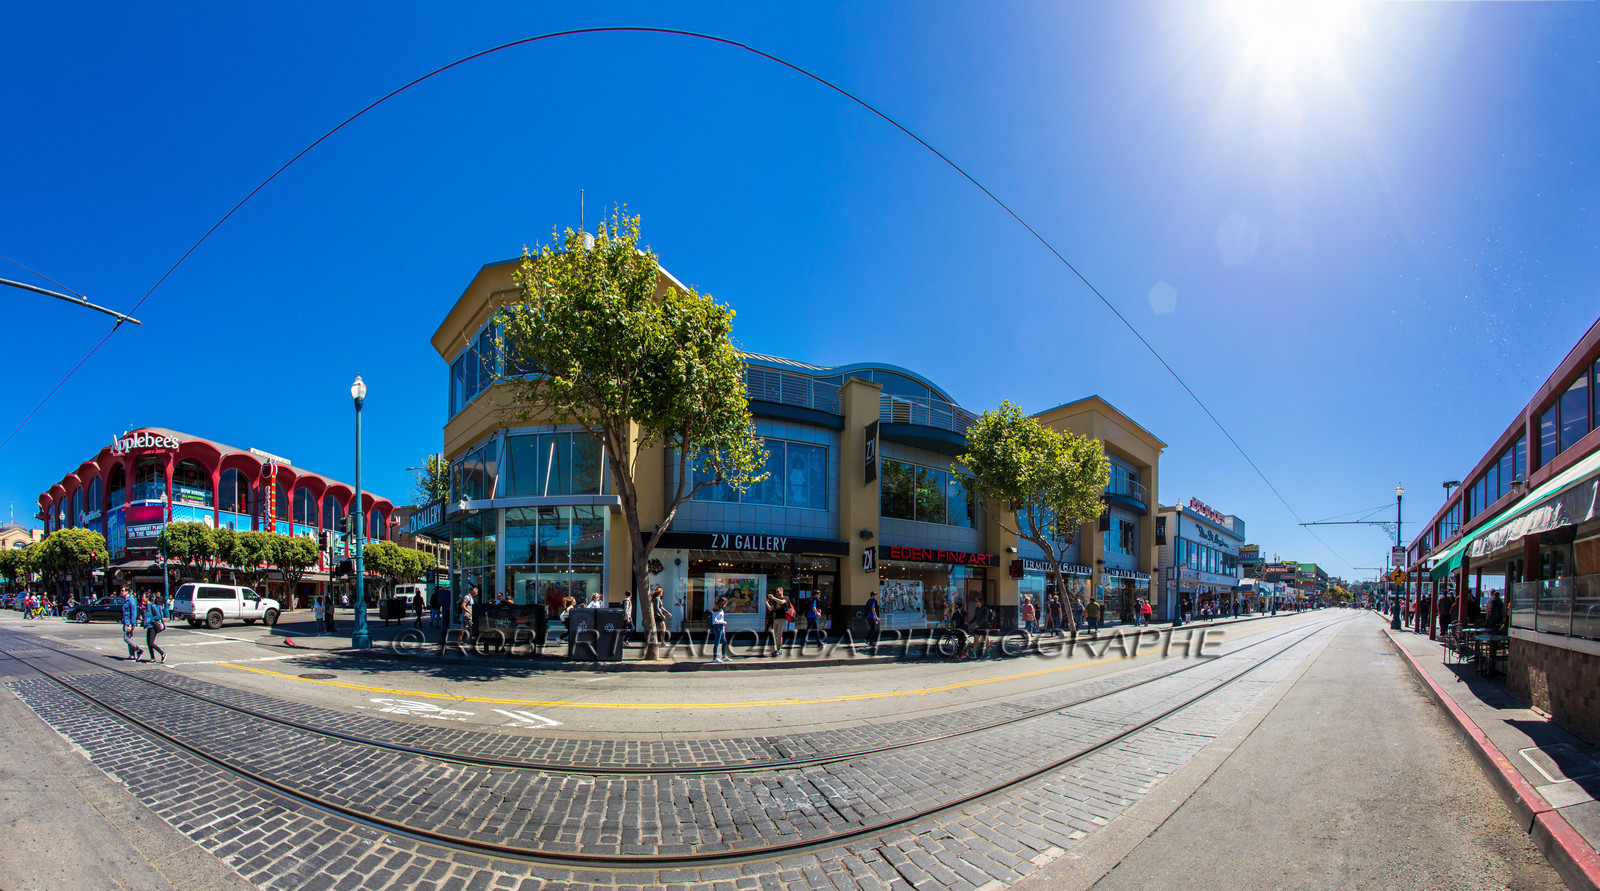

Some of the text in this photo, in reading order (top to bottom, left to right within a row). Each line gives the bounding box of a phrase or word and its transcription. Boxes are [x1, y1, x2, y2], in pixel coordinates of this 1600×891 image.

[110, 432, 179, 454] Applebee's
[191, 489, 205, 497] HIRING
[417, 502, 442, 529] GALLERY
[712, 533, 787, 551] ZK GALLERY
[890, 546, 932, 560] EDEN
[968, 554, 993, 565] ART
[1062, 563, 1092, 576] GALLERY
